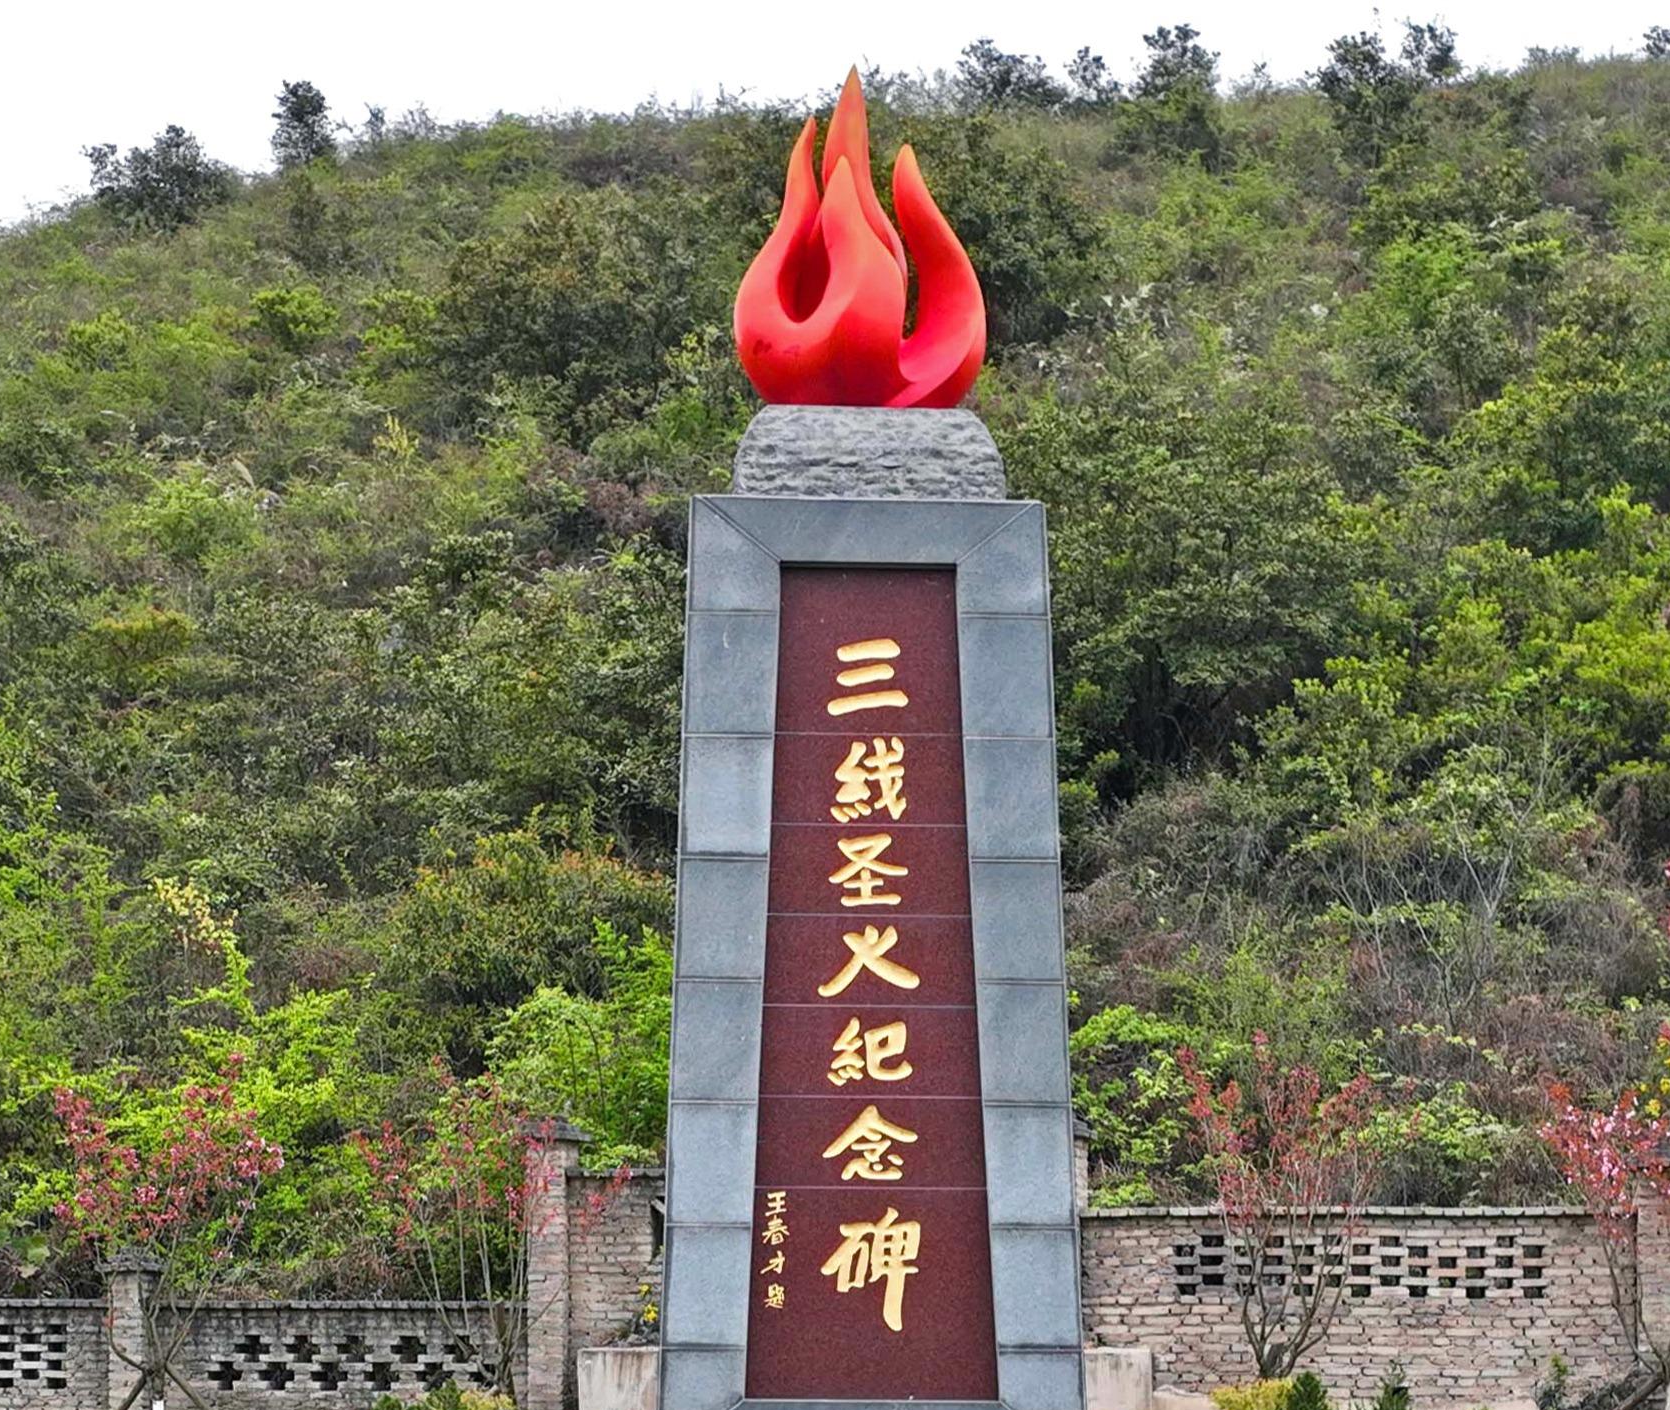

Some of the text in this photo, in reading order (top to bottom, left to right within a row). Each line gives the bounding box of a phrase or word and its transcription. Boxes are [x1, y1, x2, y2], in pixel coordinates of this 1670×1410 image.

[818, 637, 921, 1332] 三线圣火纪念碑
[760, 1191, 790, 1309] 王春才题
